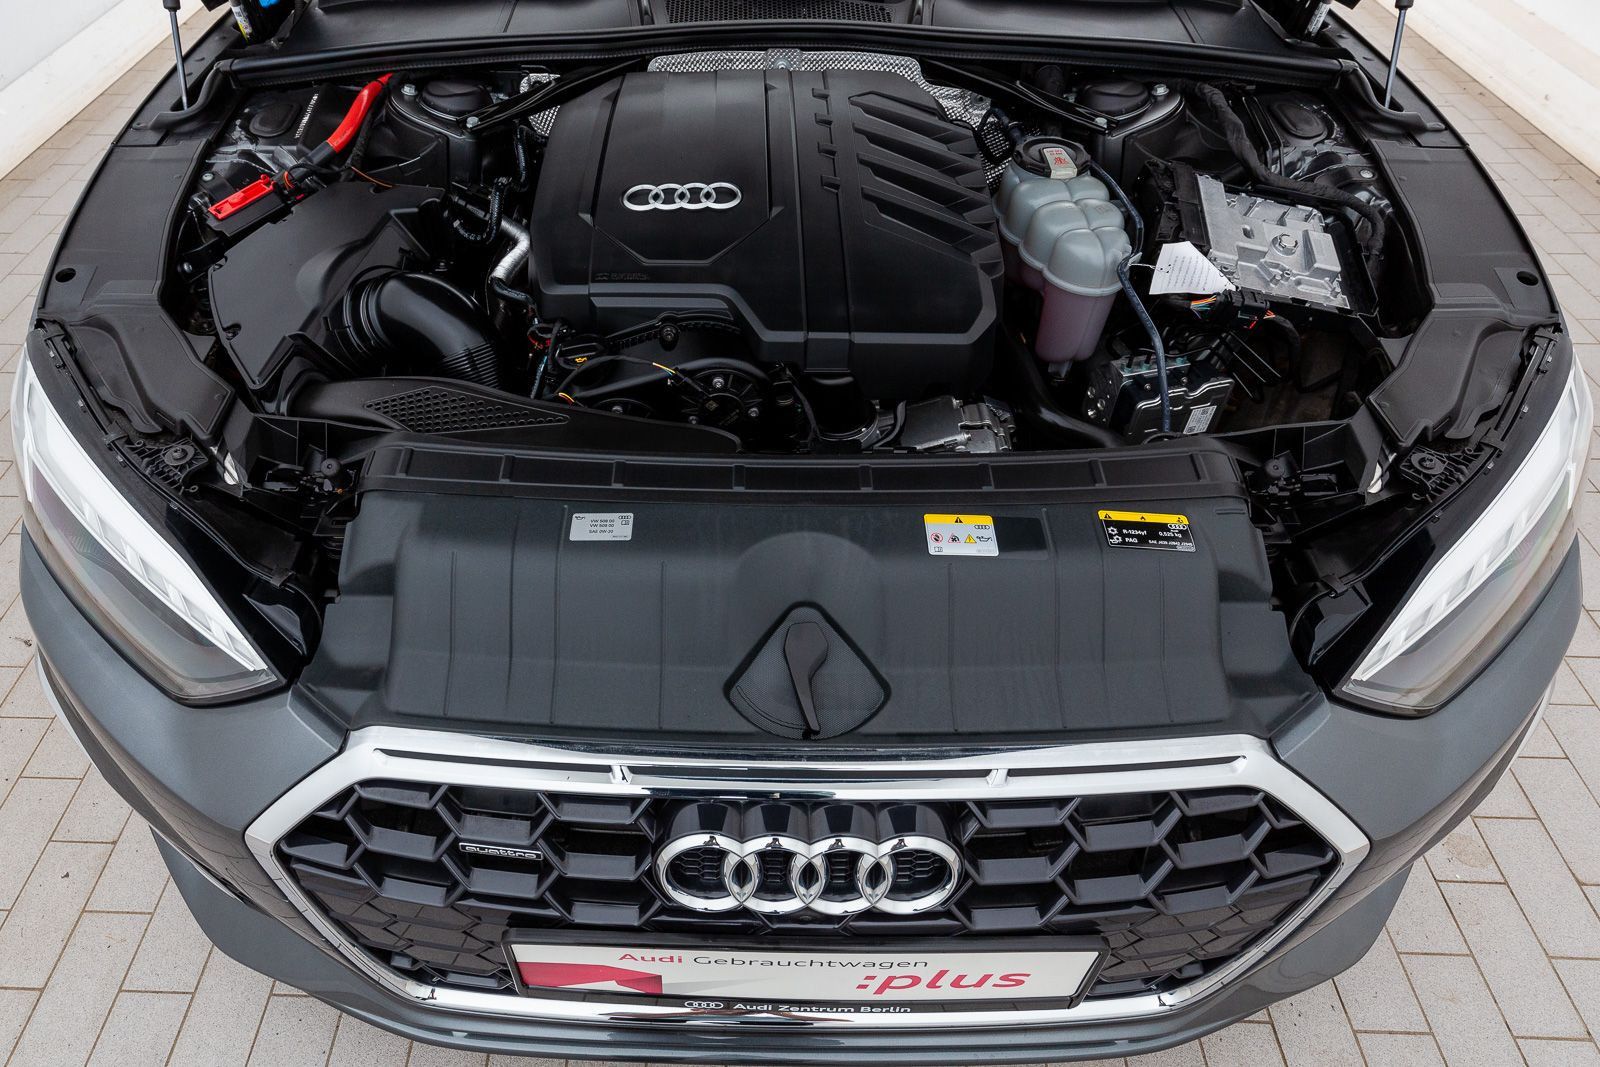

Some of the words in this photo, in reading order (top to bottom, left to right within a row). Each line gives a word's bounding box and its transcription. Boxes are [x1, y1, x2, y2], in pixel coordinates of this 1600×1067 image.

[465, 846, 537, 859] quattro
[618, 953, 683, 964] Audi
[693, 956, 928, 970] Gebrauchtwagen
[733, 1003, 773, 1011] Audi
[778, 1004, 855, 1013] Zentrum
